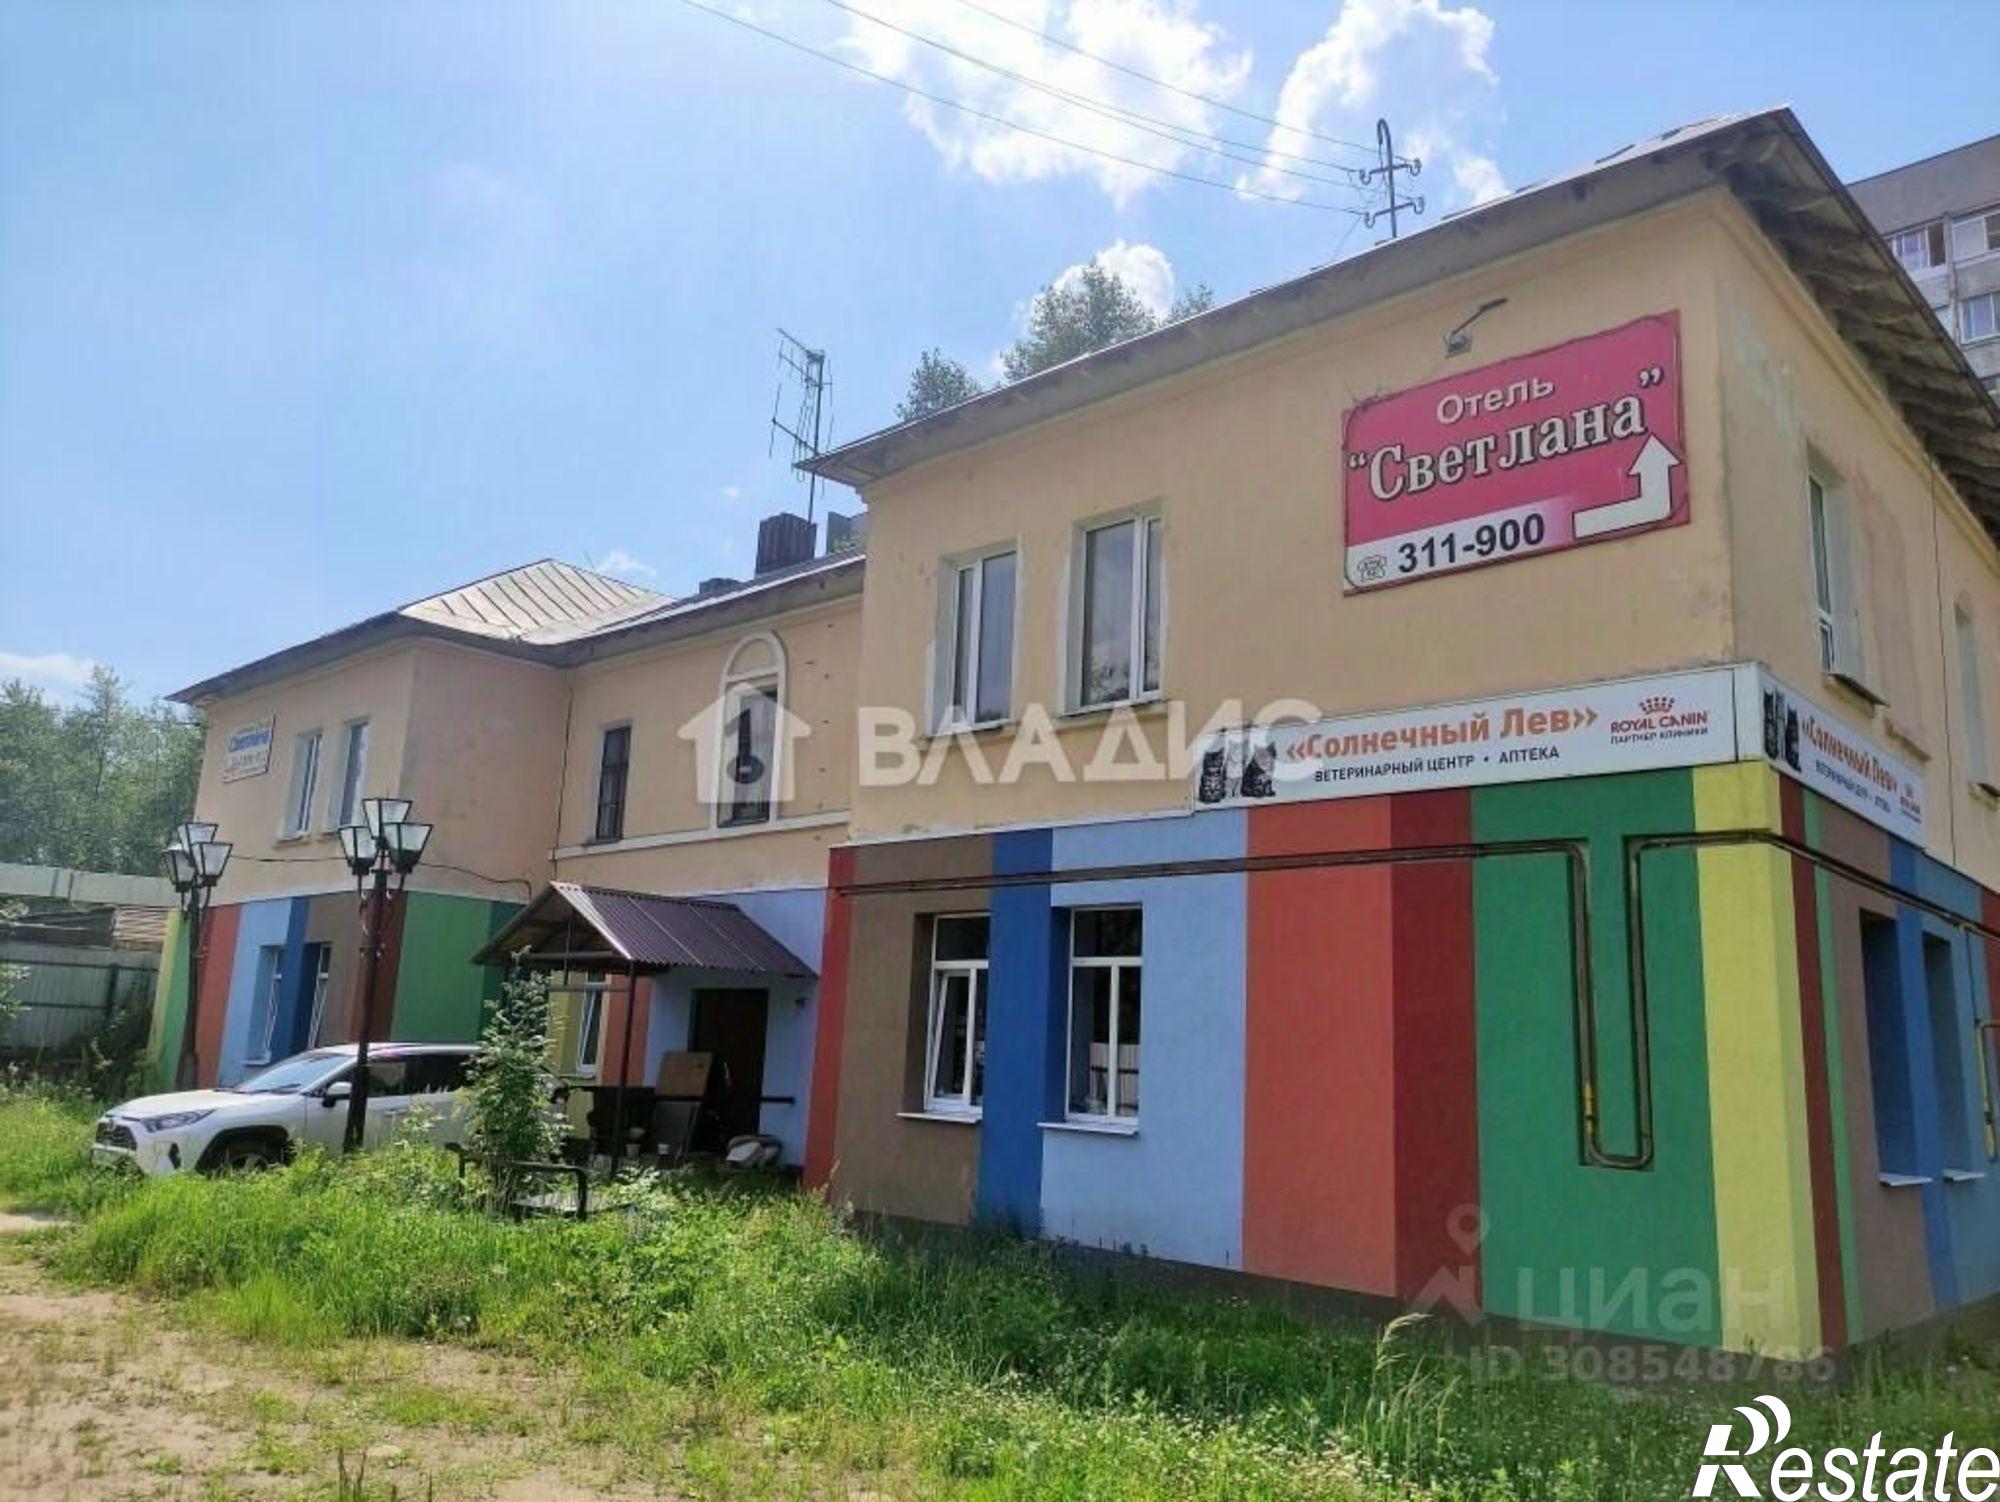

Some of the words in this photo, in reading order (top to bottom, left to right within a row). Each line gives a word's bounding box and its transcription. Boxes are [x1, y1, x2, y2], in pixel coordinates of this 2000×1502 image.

[1437, 376, 1554, 424] Отель
[1398, 512, 1545, 573] 311-900
[1500, 705, 1598, 738] Лев»
[1610, 719, 1656, 734] ROYAL
[1659, 711, 1708, 728] CANIN
[1314, 759, 1423, 782] ВЕТЕРИНАРНЫЙ
[1427, 755, 1475, 773] ЦЕНТР
[1499, 745, 1560, 764] АПТЕКА
